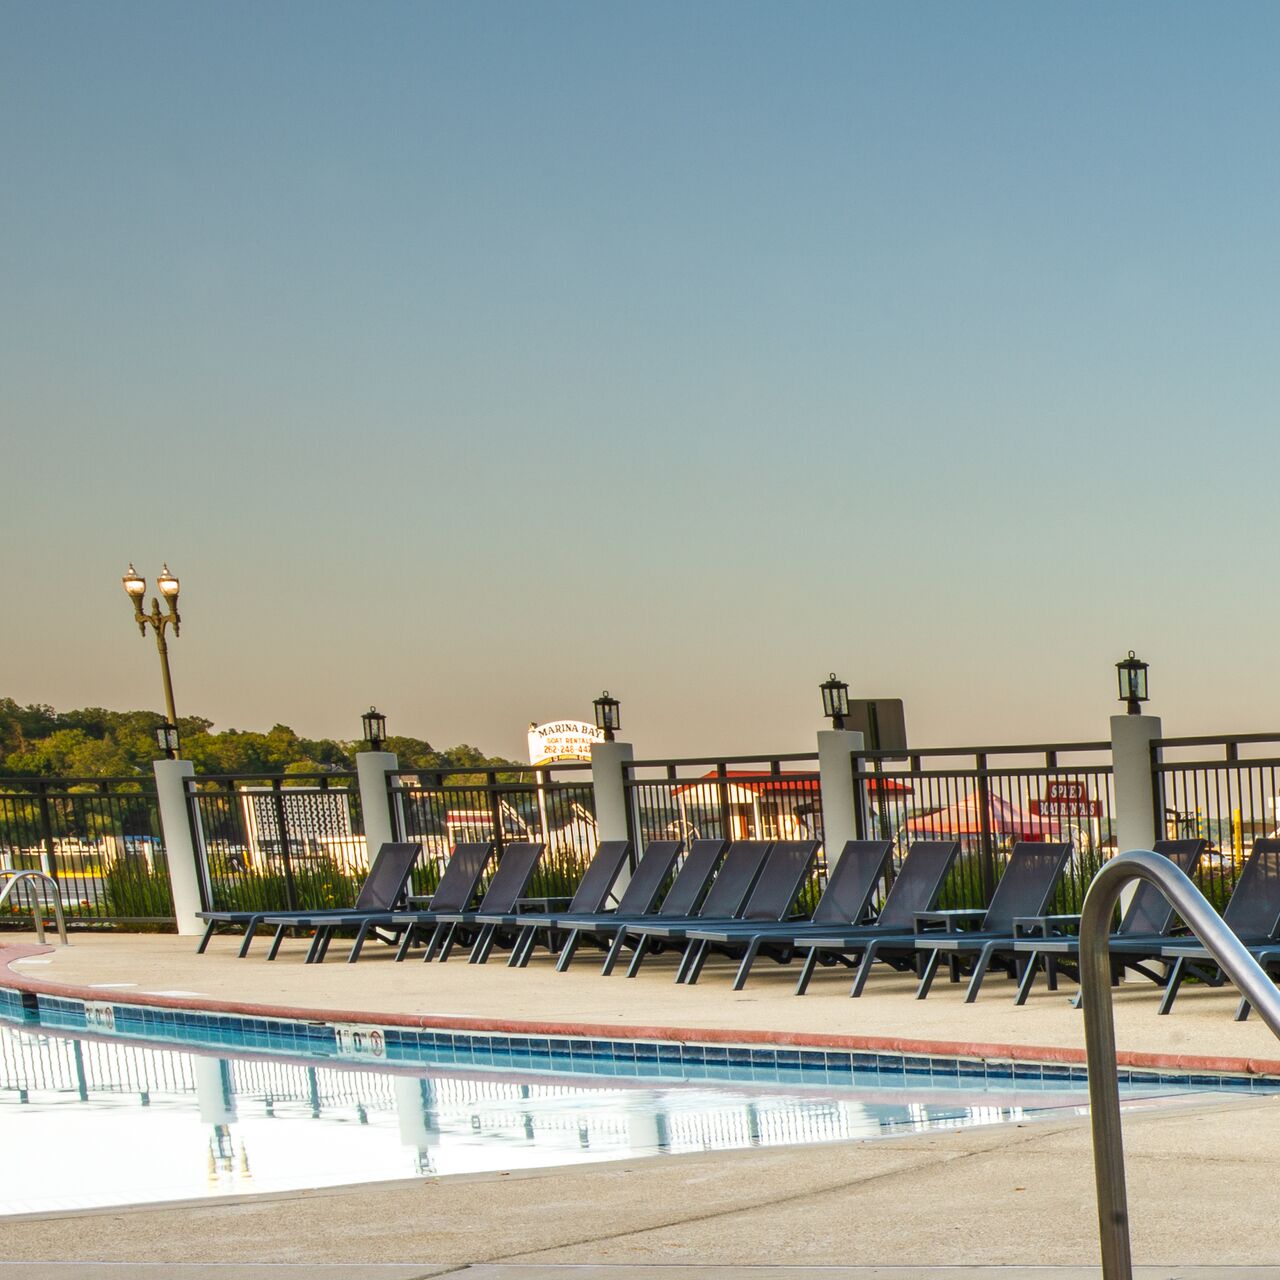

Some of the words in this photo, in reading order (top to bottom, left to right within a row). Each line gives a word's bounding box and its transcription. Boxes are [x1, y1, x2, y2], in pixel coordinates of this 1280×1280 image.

[538, 723, 579, 738] MARINA
[581, 725, 602, 738] BAY
[543, 745, 592, 753] 262-248-447
[1060, 802, 1095, 815] RNAS
